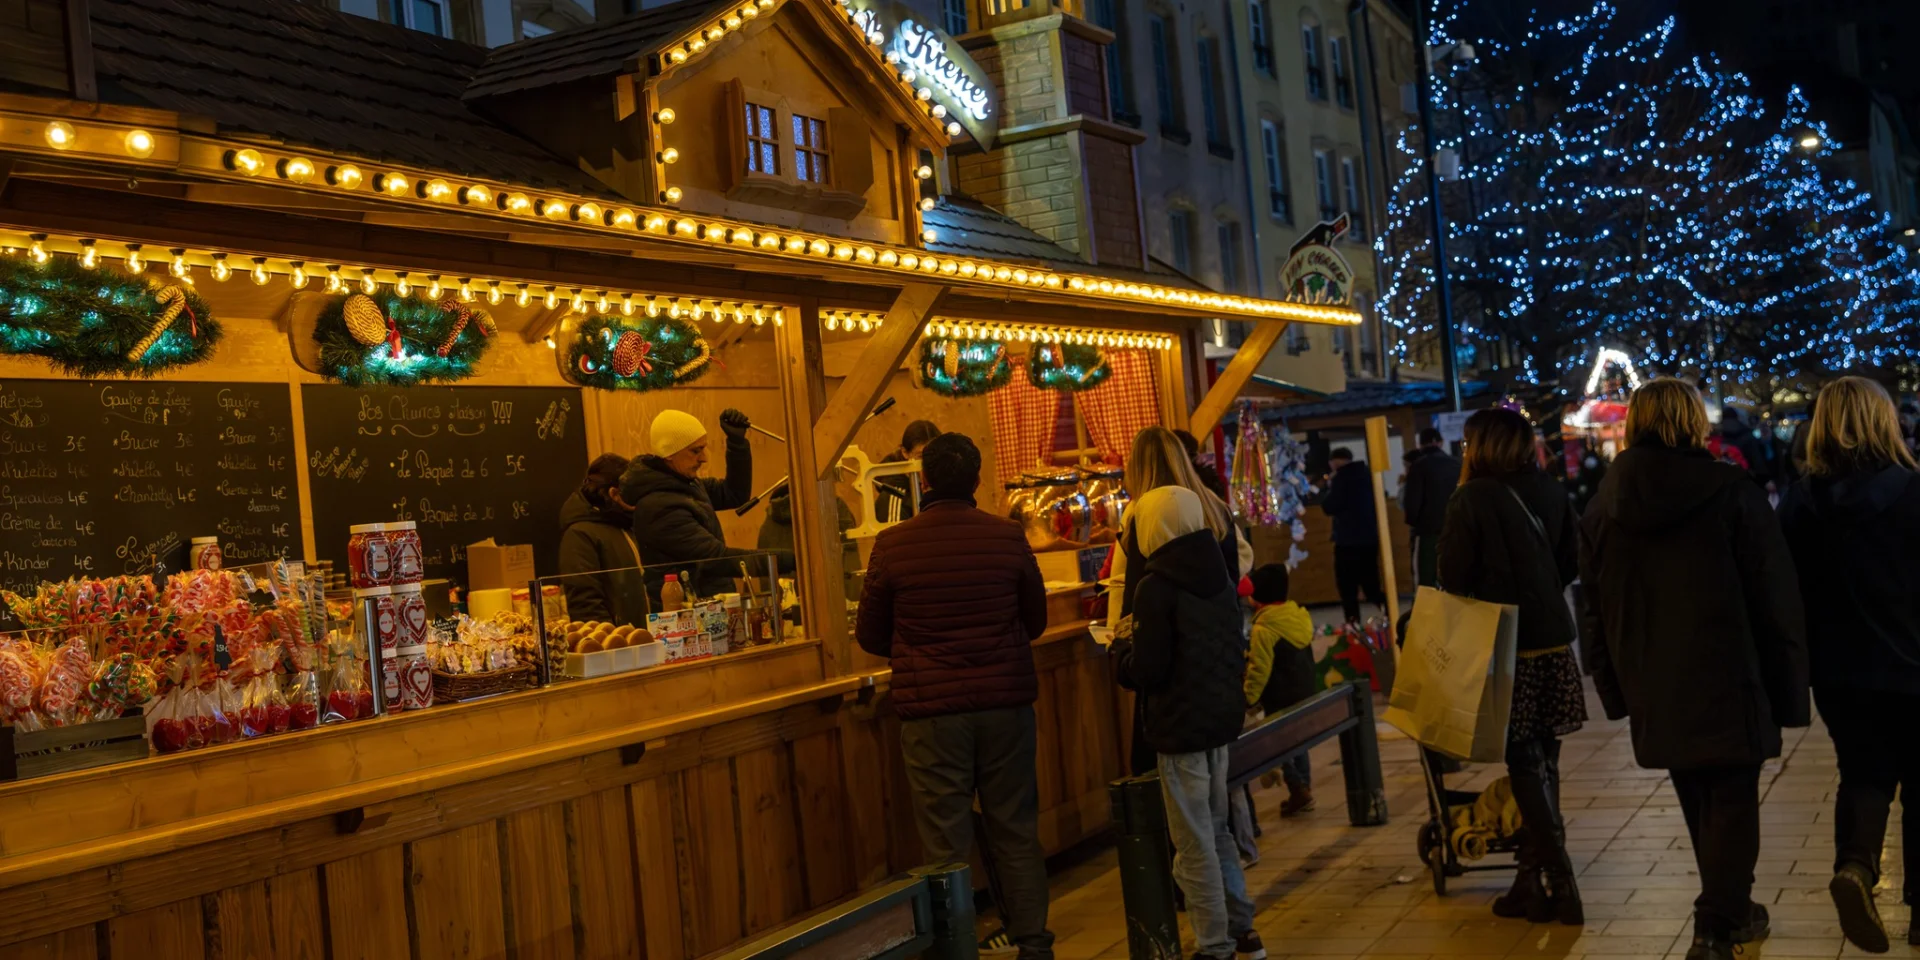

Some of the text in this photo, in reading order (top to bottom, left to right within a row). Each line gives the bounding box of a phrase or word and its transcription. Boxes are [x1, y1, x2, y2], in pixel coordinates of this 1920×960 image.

[905, 21, 992, 113] Kiener
[101, 386, 143, 413] Gaufre
[148, 389, 160, 405] de
[217, 388, 260, 413] Gaufre
[389, 395, 440, 421] Churros
[0, 430, 87, 455] Sucre 3€
[121, 430, 194, 450] Sucre 3€
[224, 426, 257, 446] Sucre
[268, 454, 286, 473] 4€
[415, 449, 454, 486] Paquet
[461, 458, 476, 478] de
[480, 457, 489, 478] 6
[505, 455, 526, 476] 5€
[68, 490, 89, 507] 4€
[177, 486, 197, 503] 4€
[271, 485, 287, 500] 4€
[420, 498, 459, 529] Paquet
[463, 504, 478, 521] de
[512, 500, 530, 520] 8€
[1, 512, 95, 536] Crème de 4€
[272, 522, 290, 538] 4€
[4, 550, 95, 570] Kinder 4€
[272, 545, 291, 559] 4€
